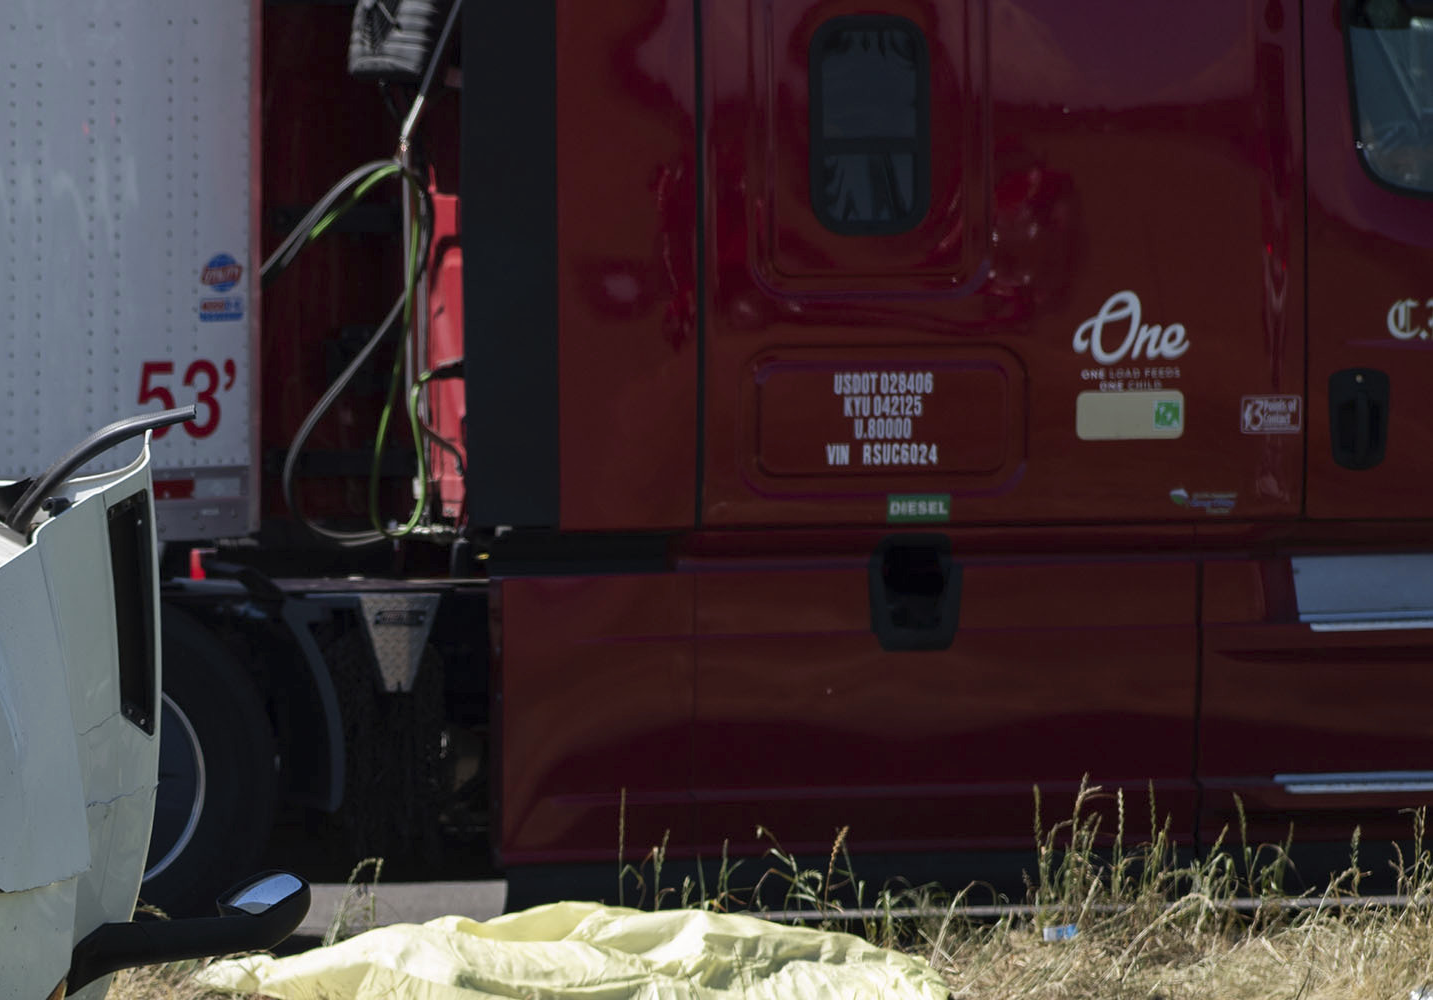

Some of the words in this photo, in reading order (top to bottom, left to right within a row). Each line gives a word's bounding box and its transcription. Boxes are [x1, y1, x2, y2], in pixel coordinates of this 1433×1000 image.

[1073, 290, 1190, 365] One
[834, 372, 878, 395] USDOT
[880, 372, 933, 394] 028406
[1081, 369, 1105, 380] ONE
[1099, 381, 1124, 392] ONE
[138, 359, 236, 440] 53'
[844, 396, 870, 417] KYU
[873, 396, 922, 416] 042125
[826, 444, 850, 465] VIN
[862, 444, 938, 465] RSUC6024
[889, 501, 948, 515] DIESEL
